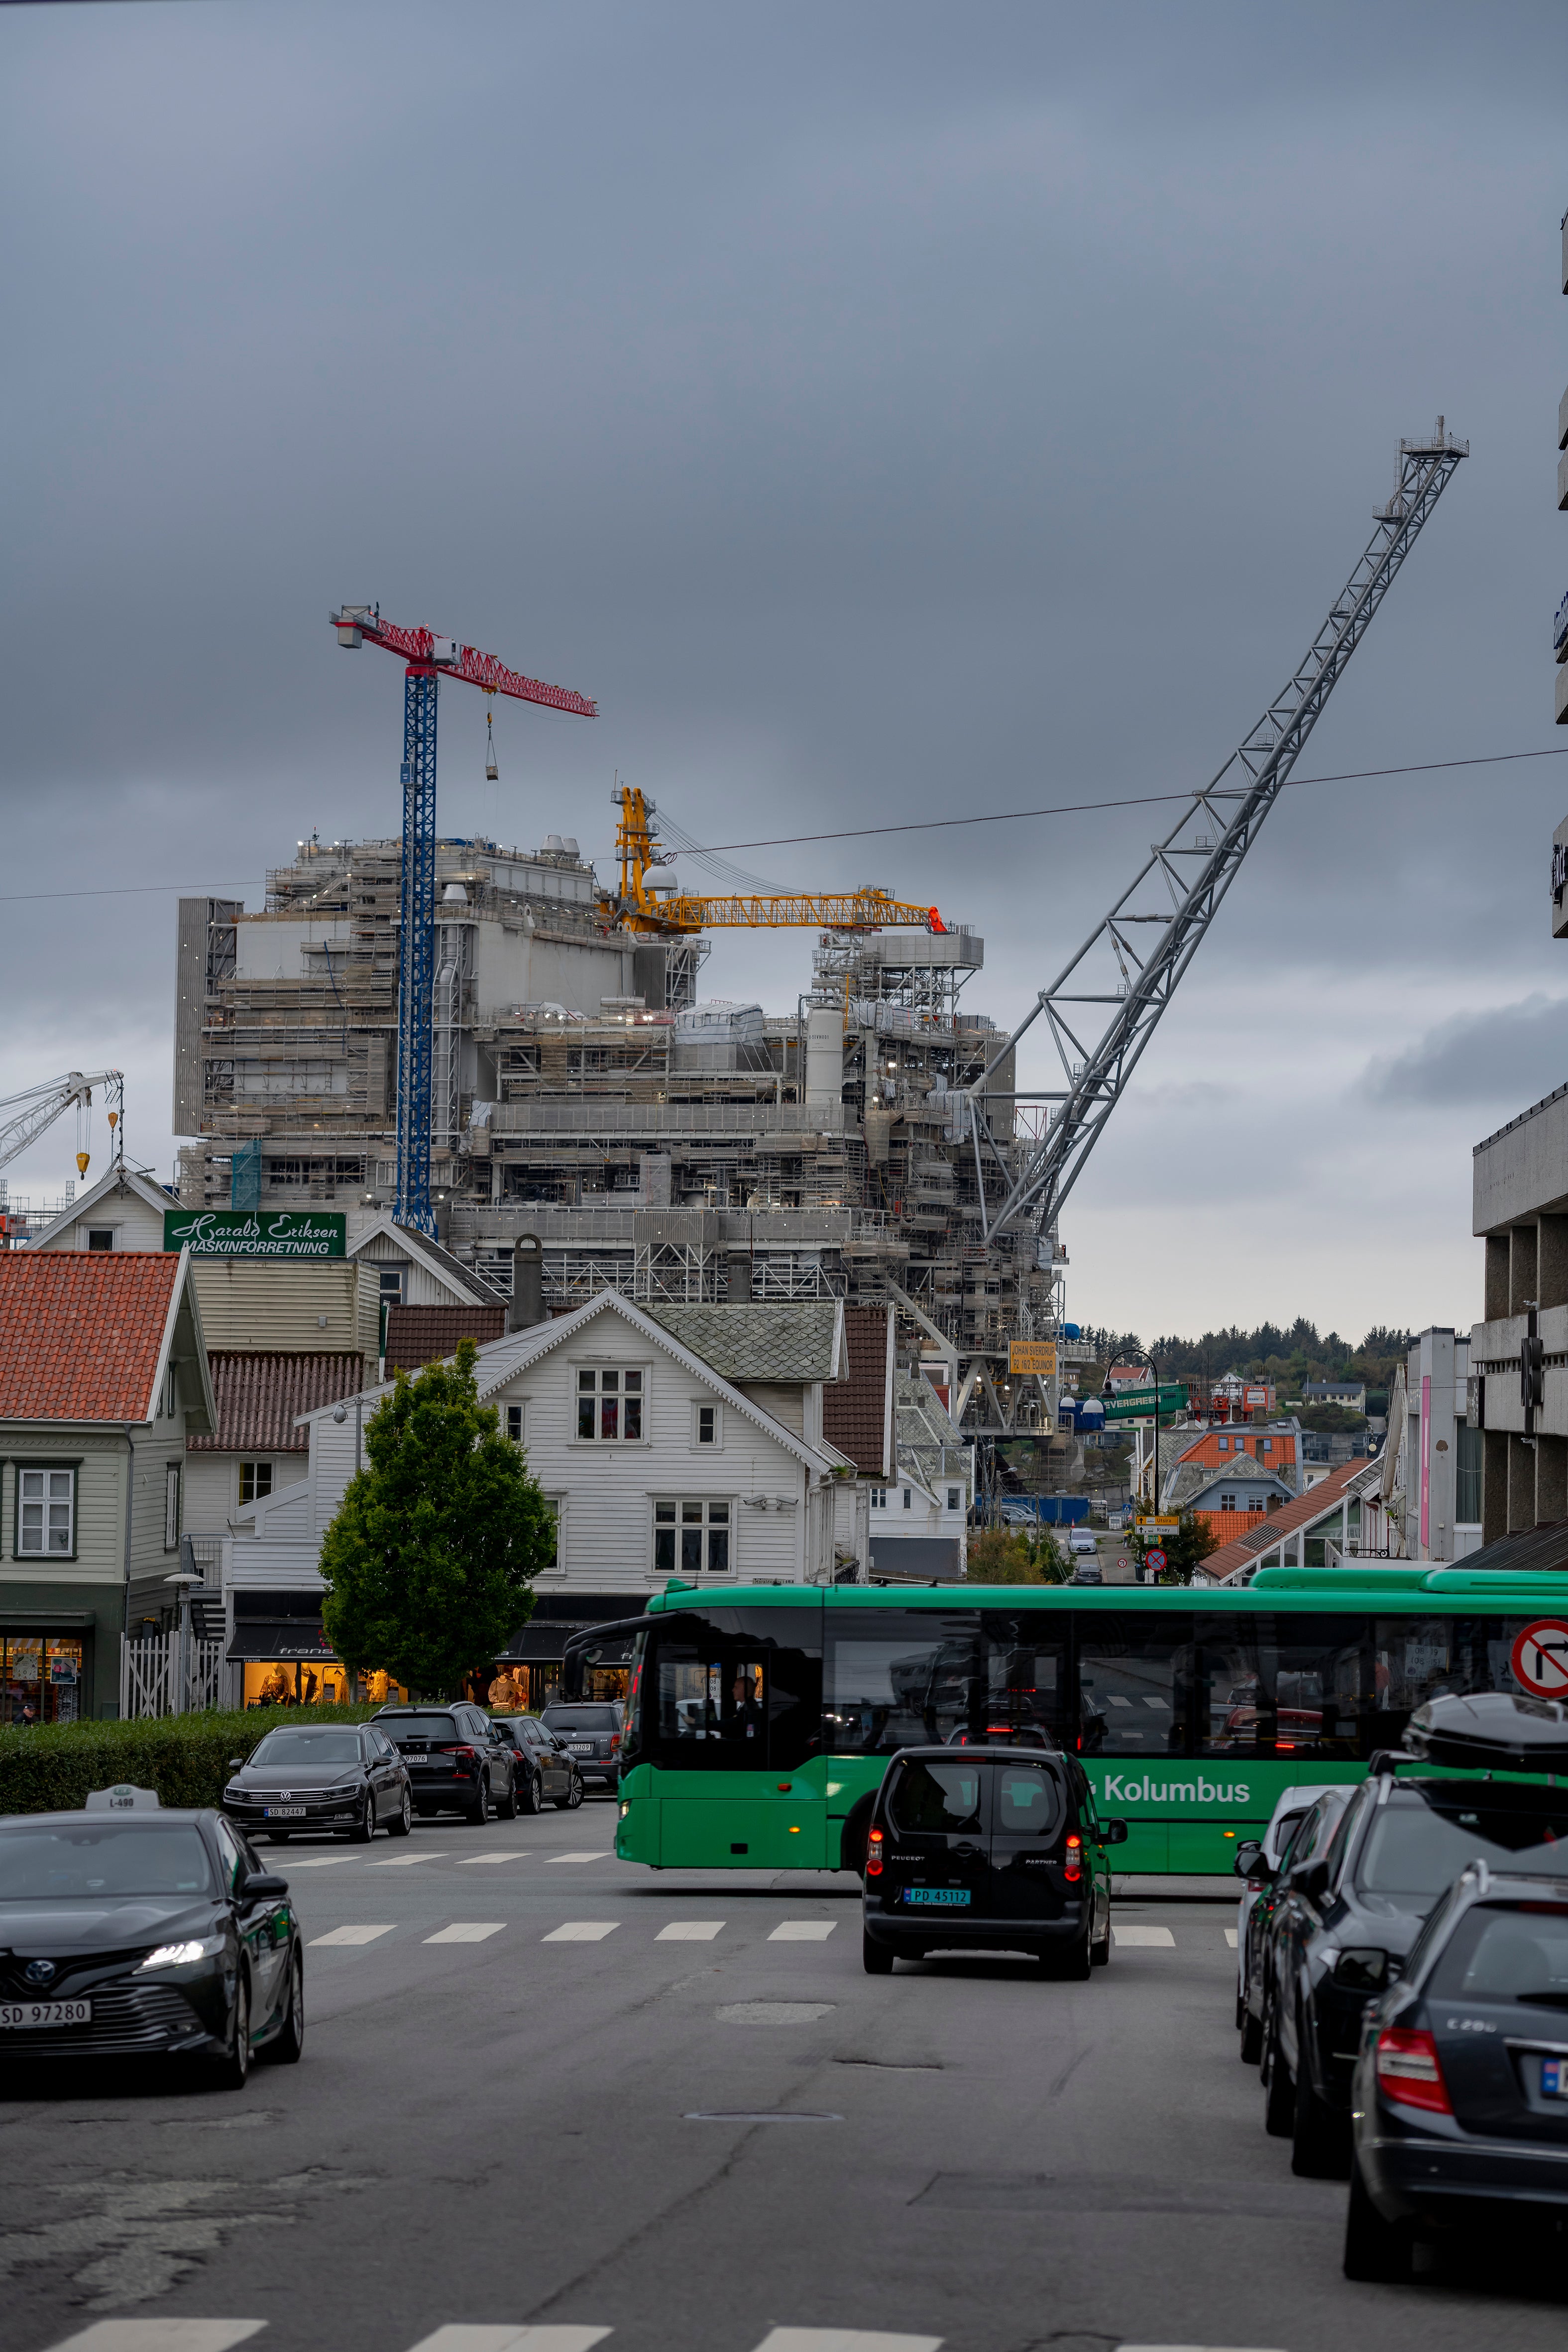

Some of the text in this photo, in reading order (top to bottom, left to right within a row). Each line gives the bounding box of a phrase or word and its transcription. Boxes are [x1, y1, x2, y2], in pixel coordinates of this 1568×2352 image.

[172, 1213, 338, 1242] Harald Eriksen
[181, 1240, 329, 1254] MASKINFORRETNING
[1012, 1345, 1054, 1356] JOHAN SVERDRUP
[1013, 1359, 1019, 1369] P2
[1032, 1360, 1053, 1370] EQUINOR
[1104, 1395, 1161, 1410] EVERGREEN
[1105, 1775, 1250, 1802] Kolumbus
[110, 1798, 133, 1807] L-490
[915, 1890, 966, 1902] PD 45112
[2, 2004, 85, 2023] SD 97280
